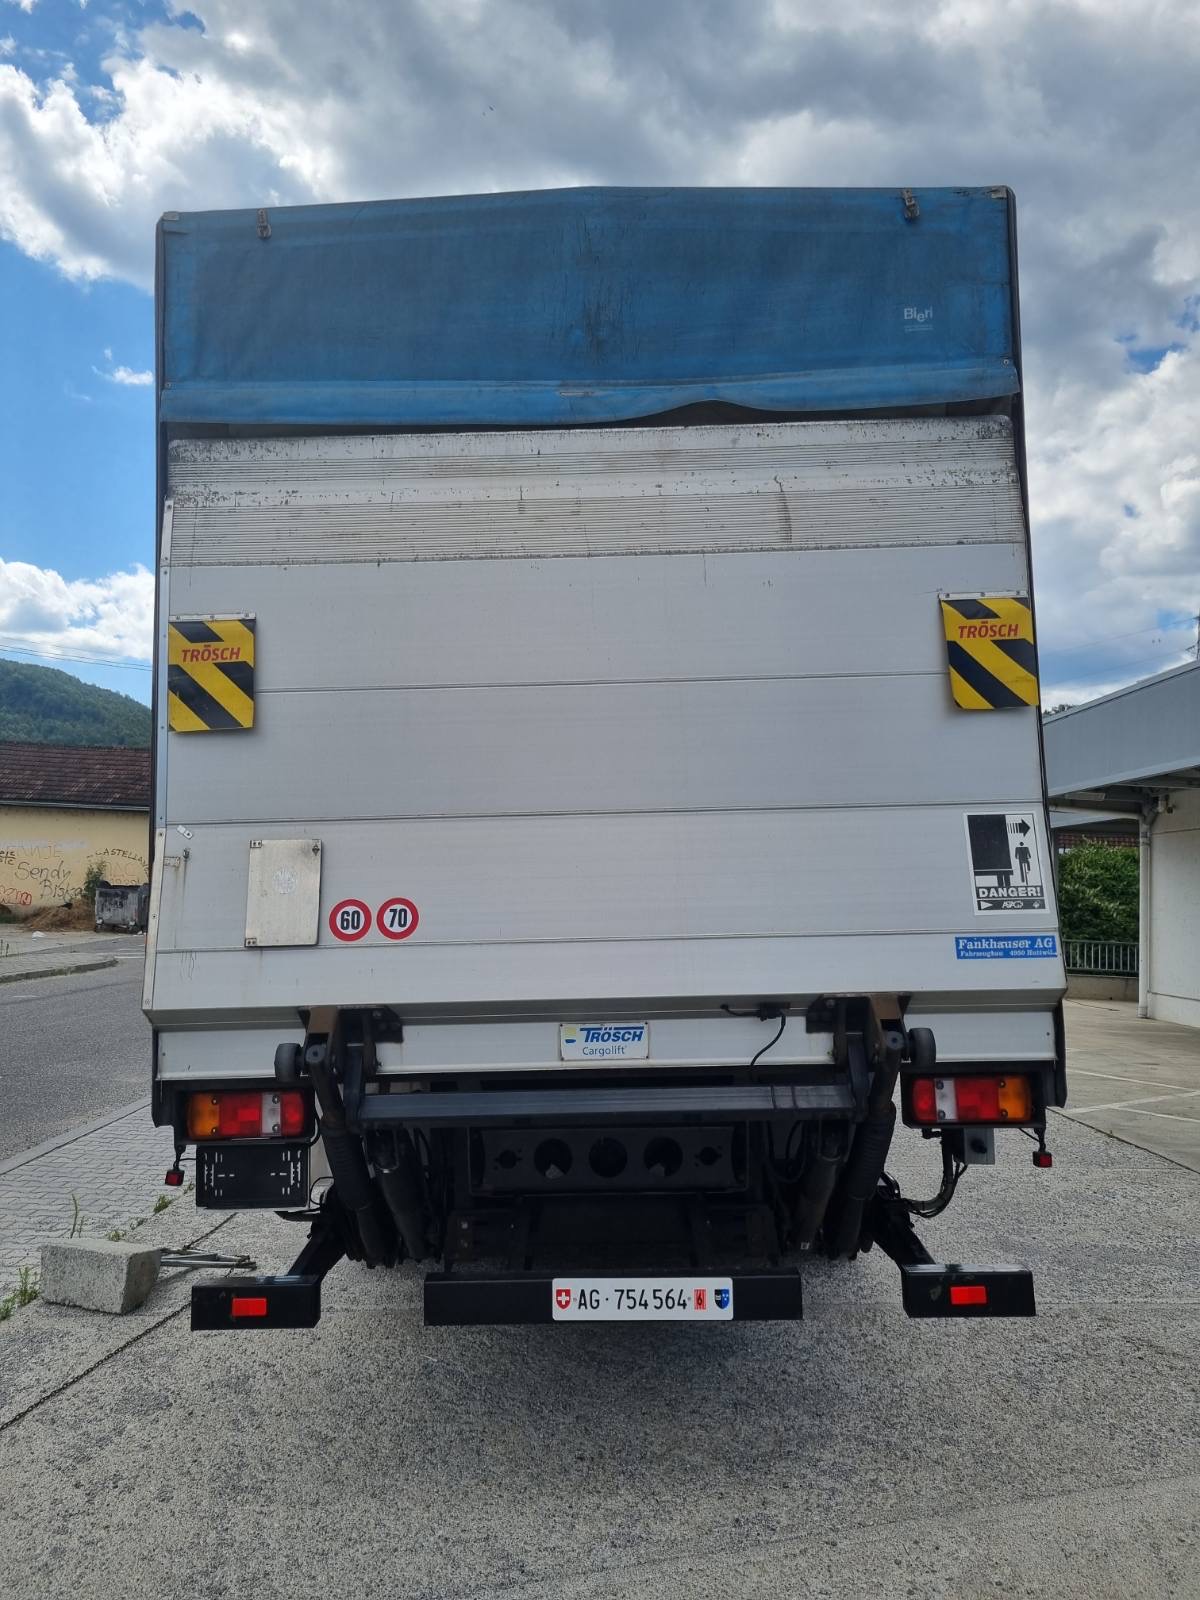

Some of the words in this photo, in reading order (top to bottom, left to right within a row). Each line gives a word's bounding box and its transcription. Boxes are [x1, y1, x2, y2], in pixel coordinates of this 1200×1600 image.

[958, 620, 1019, 639] TRÖSCH
[181, 644, 241, 663] TRÖSCH
[978, 886, 1041, 898] DANGER!
[340, 910, 361, 931] 60
[389, 908, 408, 928] 70
[958, 937, 1031, 950] Fankhauser
[1034, 937, 1053, 949] AG
[580, 1026, 645, 1043] TRÖSCH
[582, 1045, 625, 1057] Cargolift
